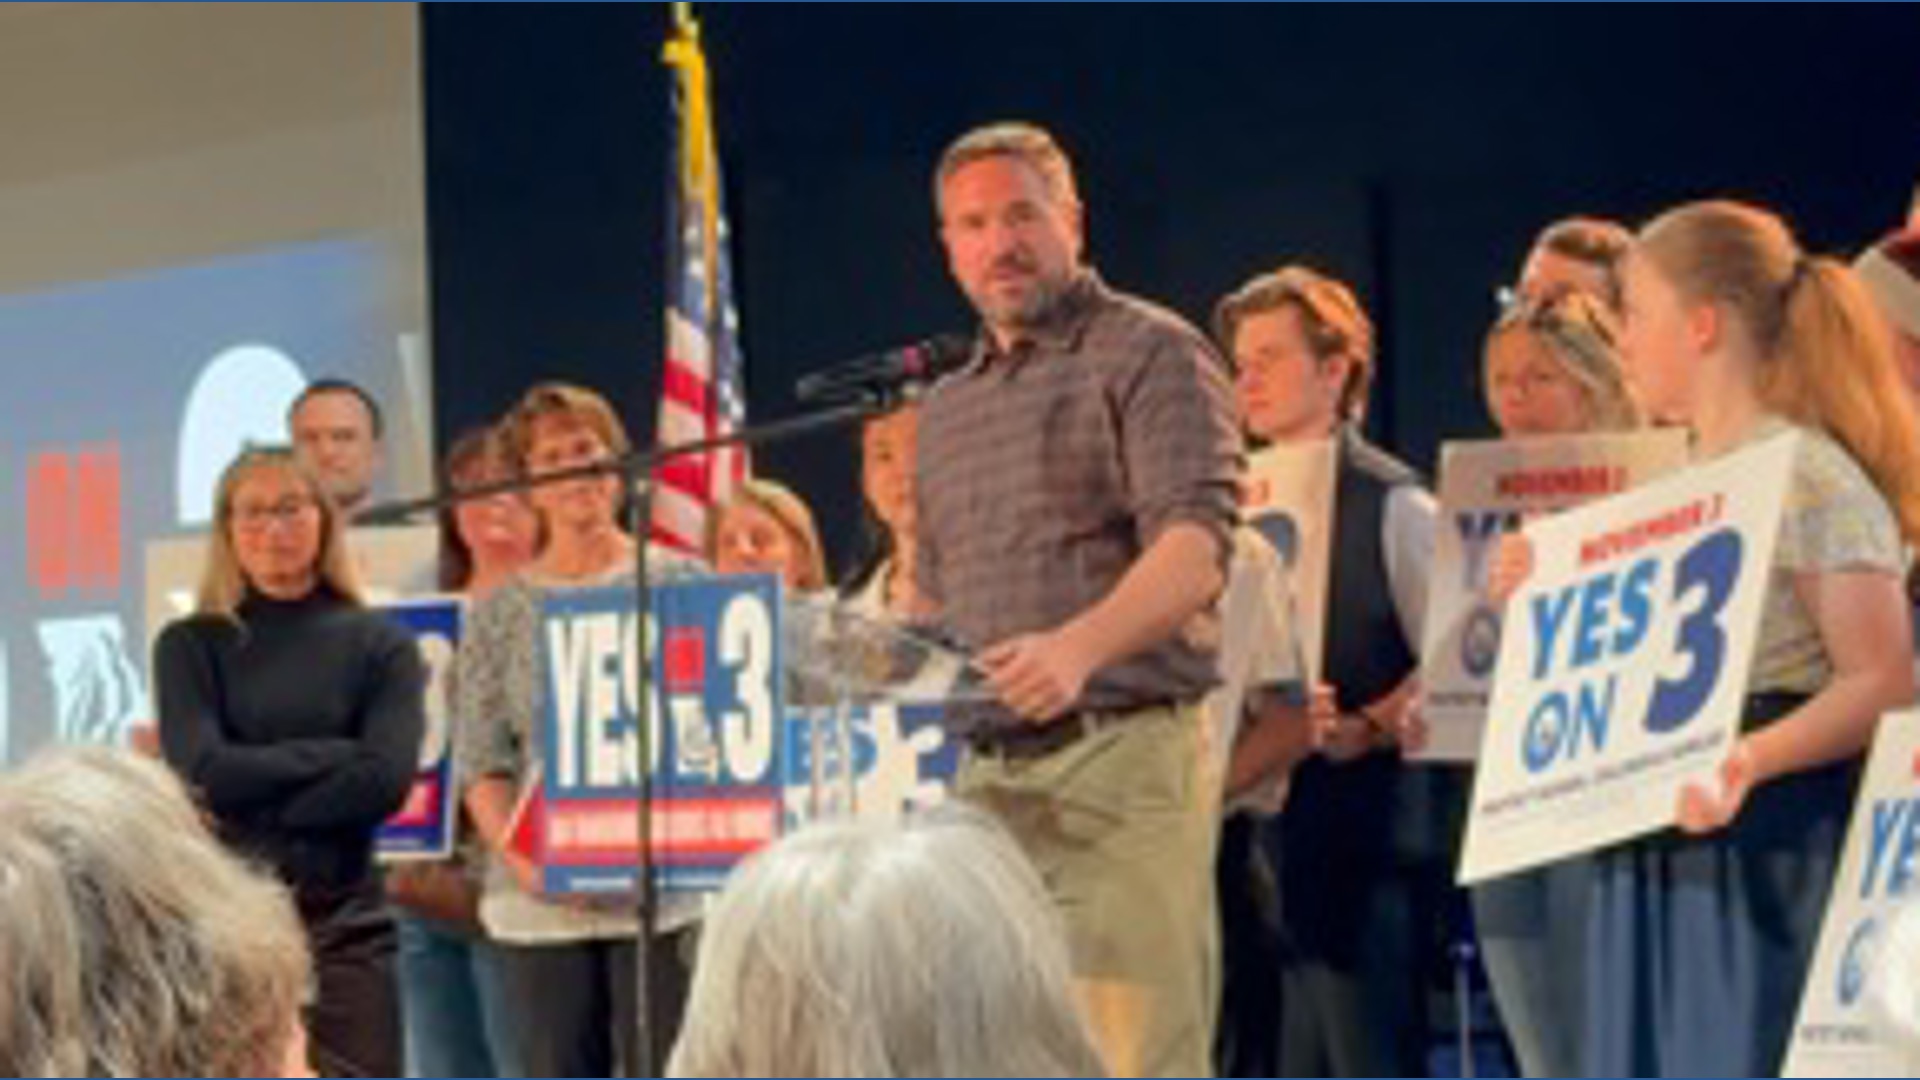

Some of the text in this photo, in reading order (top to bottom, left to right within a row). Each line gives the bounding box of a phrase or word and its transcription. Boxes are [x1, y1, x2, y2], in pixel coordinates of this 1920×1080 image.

[717, 592, 773, 783] 3
[1530, 558, 1661, 679] YES
[1642, 526, 1743, 735] 3
[546, 609, 661, 789] YES
[1521, 674, 1618, 774] ON
[1858, 797, 1920, 899] YE
